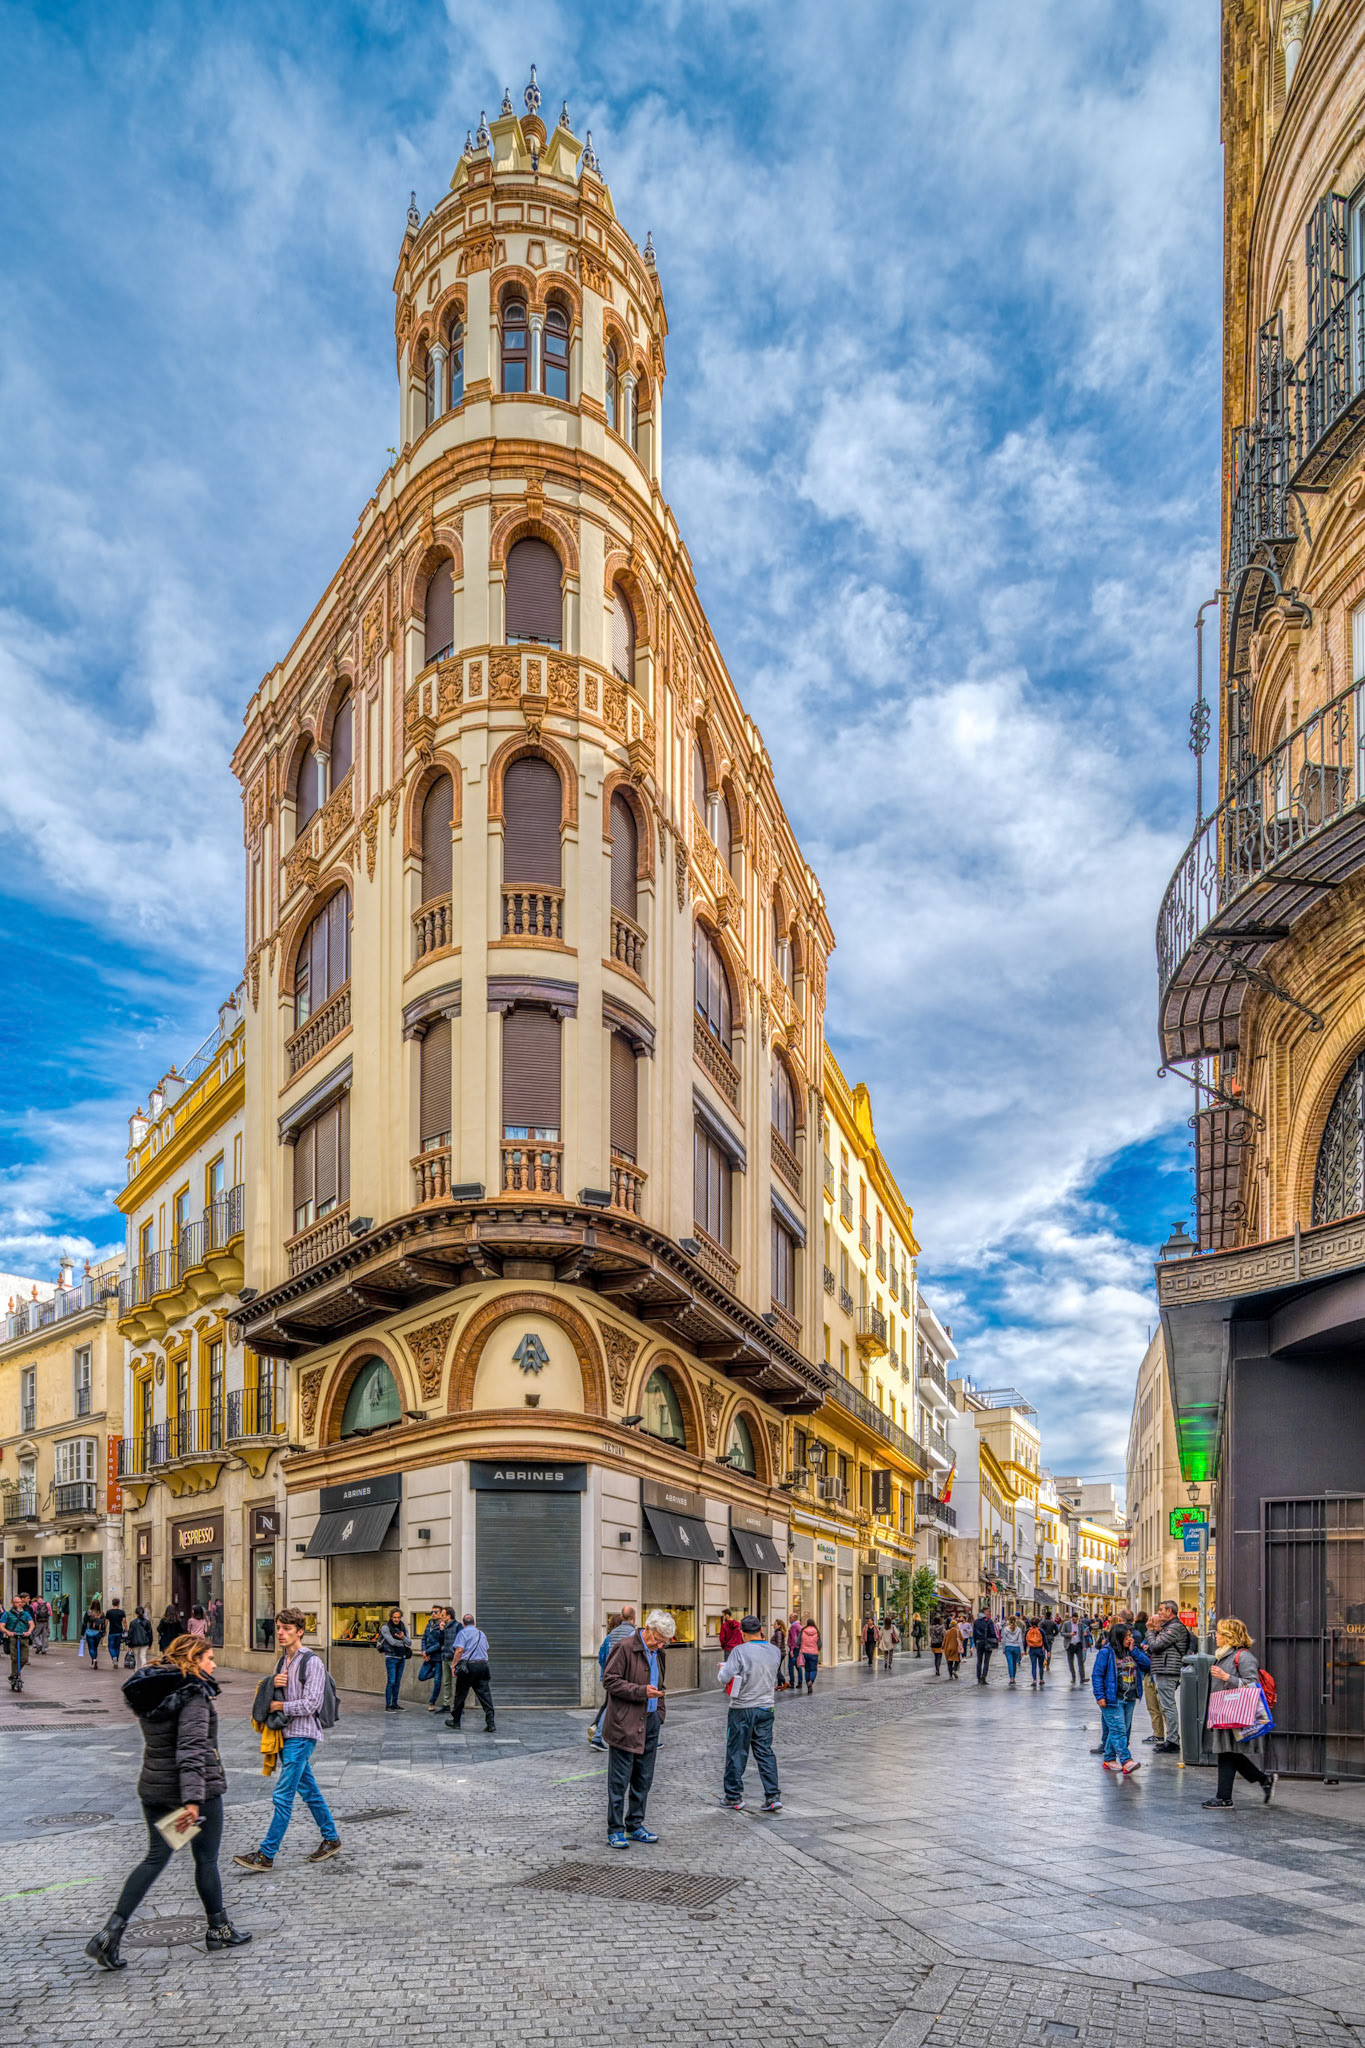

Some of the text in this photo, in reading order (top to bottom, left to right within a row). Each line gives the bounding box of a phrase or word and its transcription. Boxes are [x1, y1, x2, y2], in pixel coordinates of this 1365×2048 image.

[493, 1471, 564, 1481] ABRINES
[343, 1487, 371, 1499] ABRINES
[665, 1493, 688, 1506] ABRINES
[178, 1526, 214, 1549] NESPRESSO
